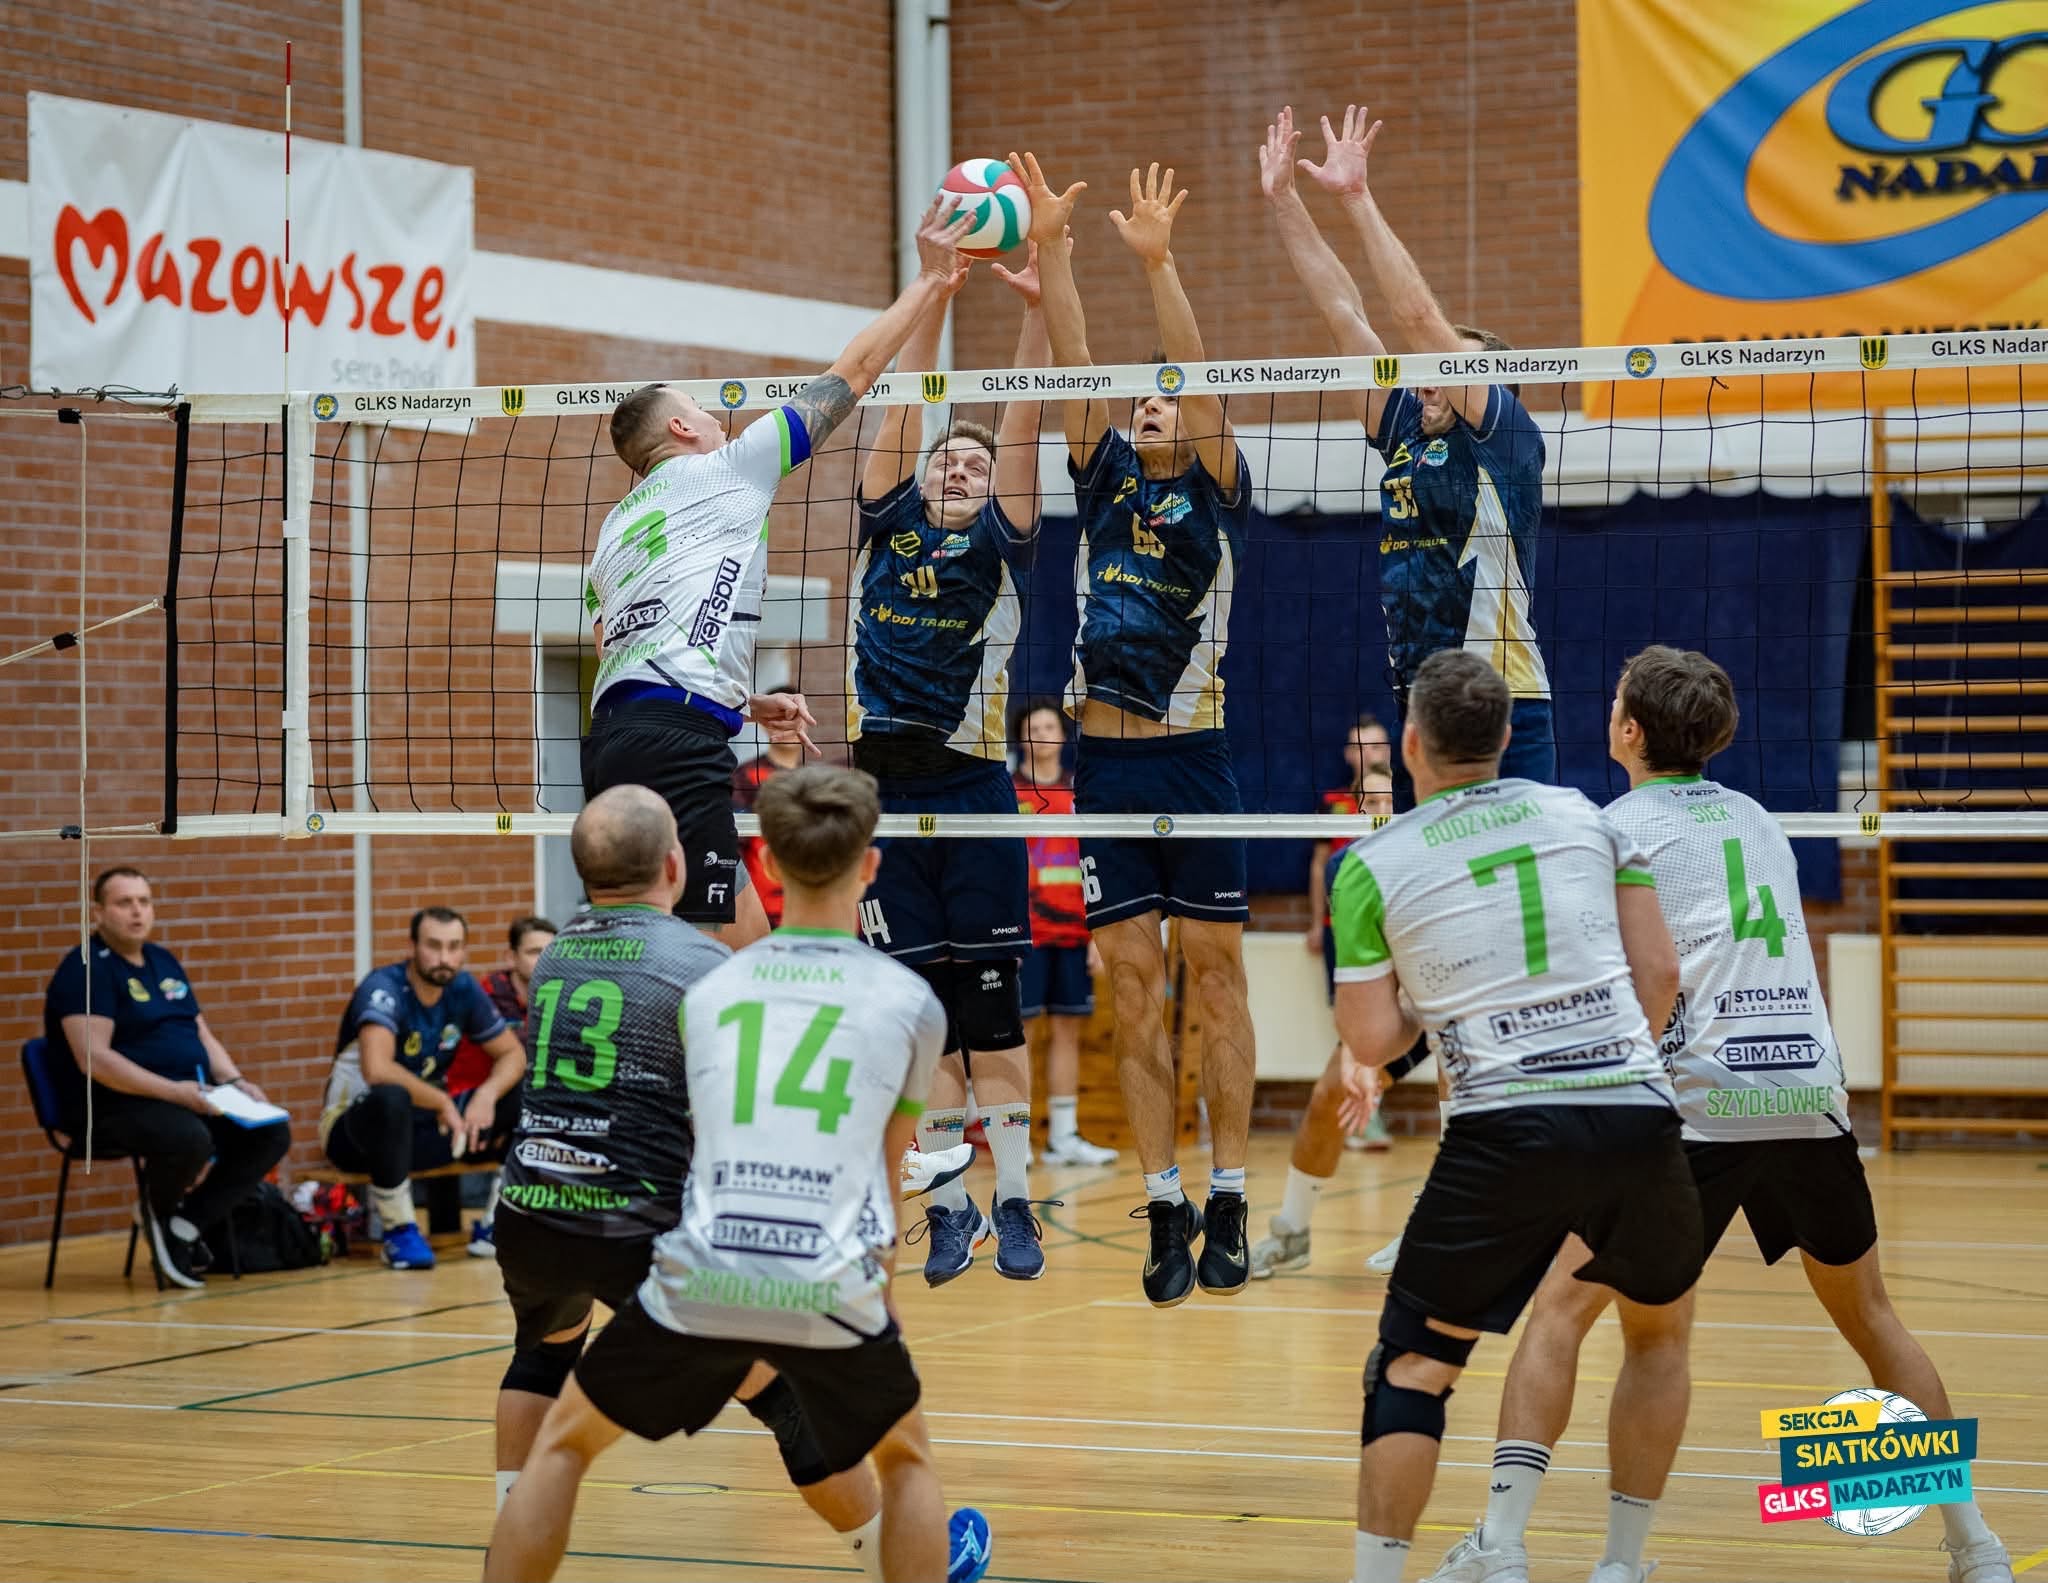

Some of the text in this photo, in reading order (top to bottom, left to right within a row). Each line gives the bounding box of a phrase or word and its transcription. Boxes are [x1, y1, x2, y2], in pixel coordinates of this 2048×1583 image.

[1680, 346, 1825, 368] GLKS Nadarzyn
[1931, 338, 1986, 357] GLKS
[1206, 365, 1340, 385] GLKS Nadarzyn
[1439, 356, 1579, 376] GLKS Nadarzyn
[982, 373, 1111, 393] GLKS Nadarzyn
[354, 394, 472, 413] GLKS Nadarzyn
[556, 389, 600, 405] GLKS
[696, 557, 741, 653] mas-lex
[920, 617, 969, 630] TRADE
[1421, 800, 1543, 848] BUDZYŃSKI
[1722, 837, 1788, 958] 4
[1466, 843, 1549, 977] 7
[751, 962, 846, 986] NOWAK
[1518, 986, 1612, 1020] STOLPAW
[1734, 987, 1809, 1003] STOLPAW
[530, 978, 625, 1092] 13
[1726, 1043, 1817, 1063] BIMART
[716, 999, 855, 1135] 14
[1706, 1085, 1836, 1119] SZYDŁOWIEC
[522, 1143, 606, 1167] BIMART
[734, 1161, 833, 1185] STOLPAW
[713, 1222, 823, 1250] BIMART
